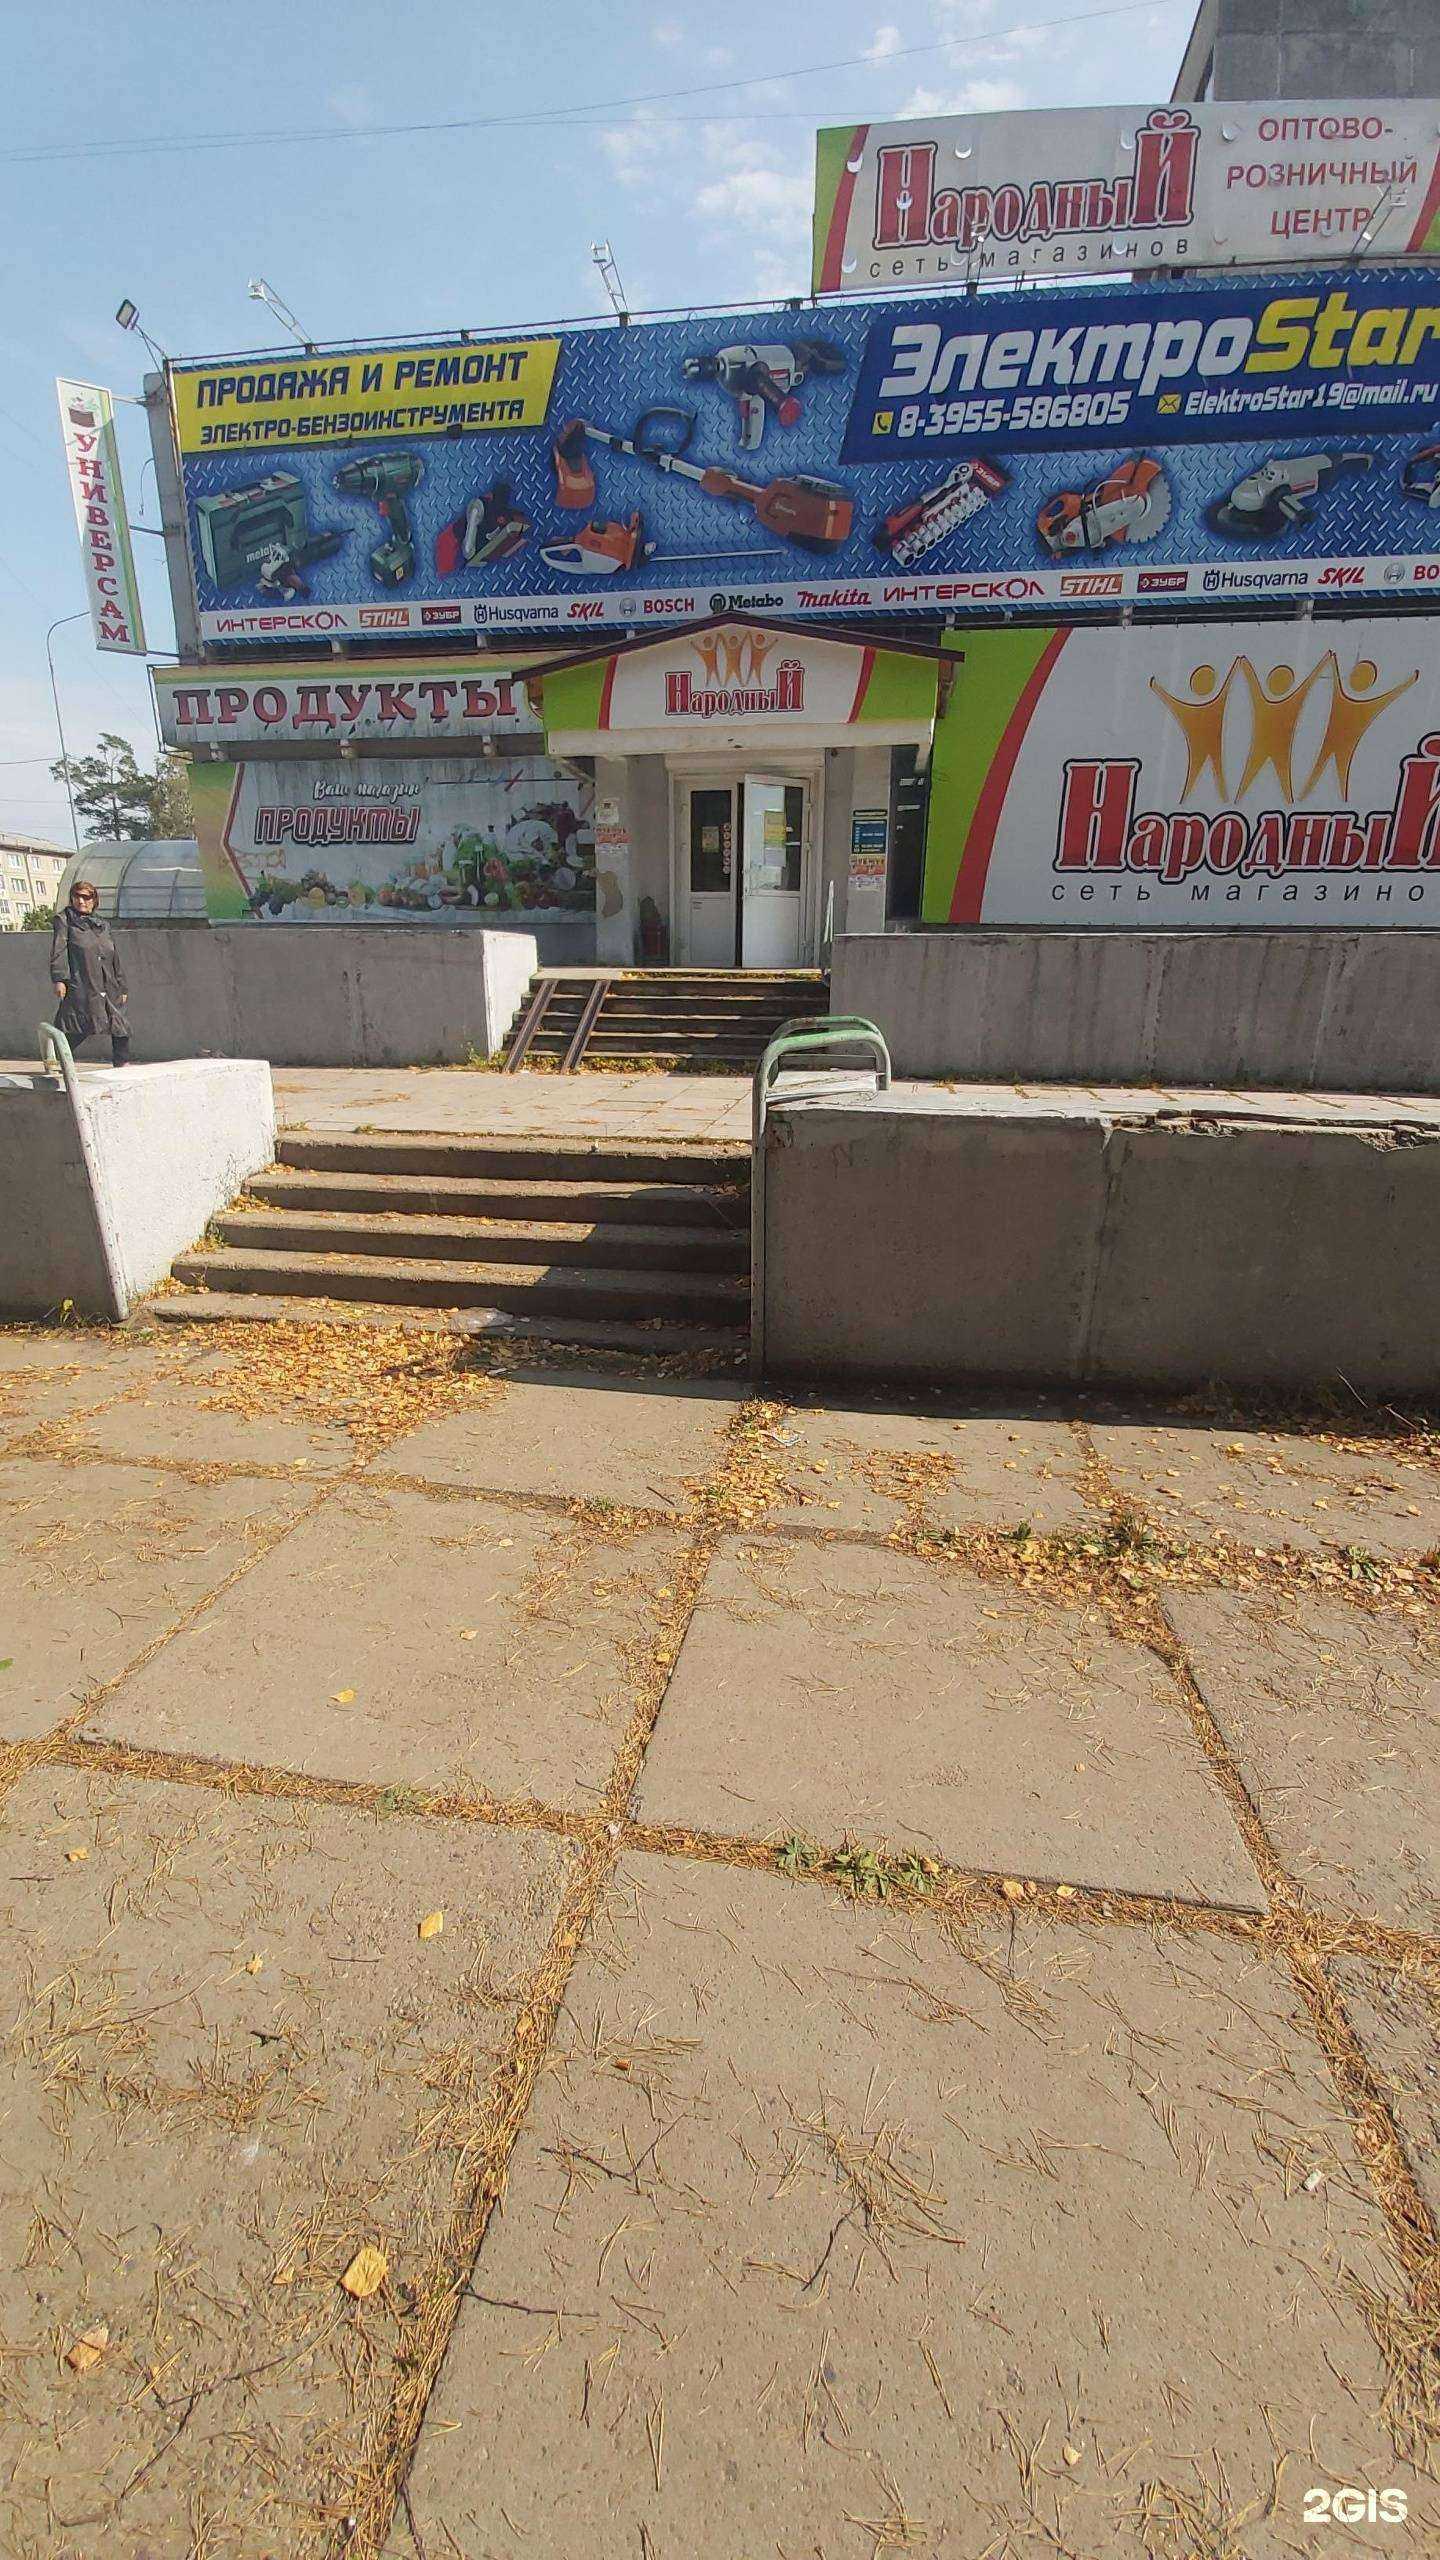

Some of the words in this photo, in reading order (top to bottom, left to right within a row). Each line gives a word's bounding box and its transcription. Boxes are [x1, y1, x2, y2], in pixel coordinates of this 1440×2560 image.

[1258, 116, 1394, 142] ОПТОВО-
[1226, 155, 1418, 190] РОЗНИЧНЫЙ
[1270, 206, 1371, 237] ЦЕНТР
[870, 254, 949, 279] сеть
[979, 237, 1188, 268] магазинов
[196, 370, 350, 410] ПРОДАЖА
[361, 363, 383, 393] И
[393, 350, 529, 390] РЕМОНТ
[1184, 378, 1439, 416] ElektroStar19@mail.ru
[200, 399, 524, 446] ЭЛЕКТРО-БЕНЗОИНСТРУМЕНТА
[897, 390, 1133, 438] 8-3955-586805
[73, 432, 131, 643] УНИВЕРСАМ
[884, 577, 1045, 602] ИНТЕРСКОЛ
[1061, 576, 1122, 596] STIHL
[1150, 576, 1186, 588] ЗУБР
[1221, 569, 1308, 590] Husqvarna
[1317, 566, 1366, 588] SKIL
[432, 609, 460, 622] ЗУБР
[489, 604, 559, 624] Husqvarna
[567, 601, 605, 621] SKIL
[643, 597, 695, 614] BOSCH
[216, 610, 348, 633] ИНТЕРСКОЛ
[360, 609, 409, 628] STIHL
[172, 677, 518, 730] ПРОДУКТЫ
[313, 779, 348, 800] Ваш
[355, 782, 421, 804] магазин
[254, 805, 421, 847] ПРОДУКТЫ
[1052, 883, 1151, 902] сеть
